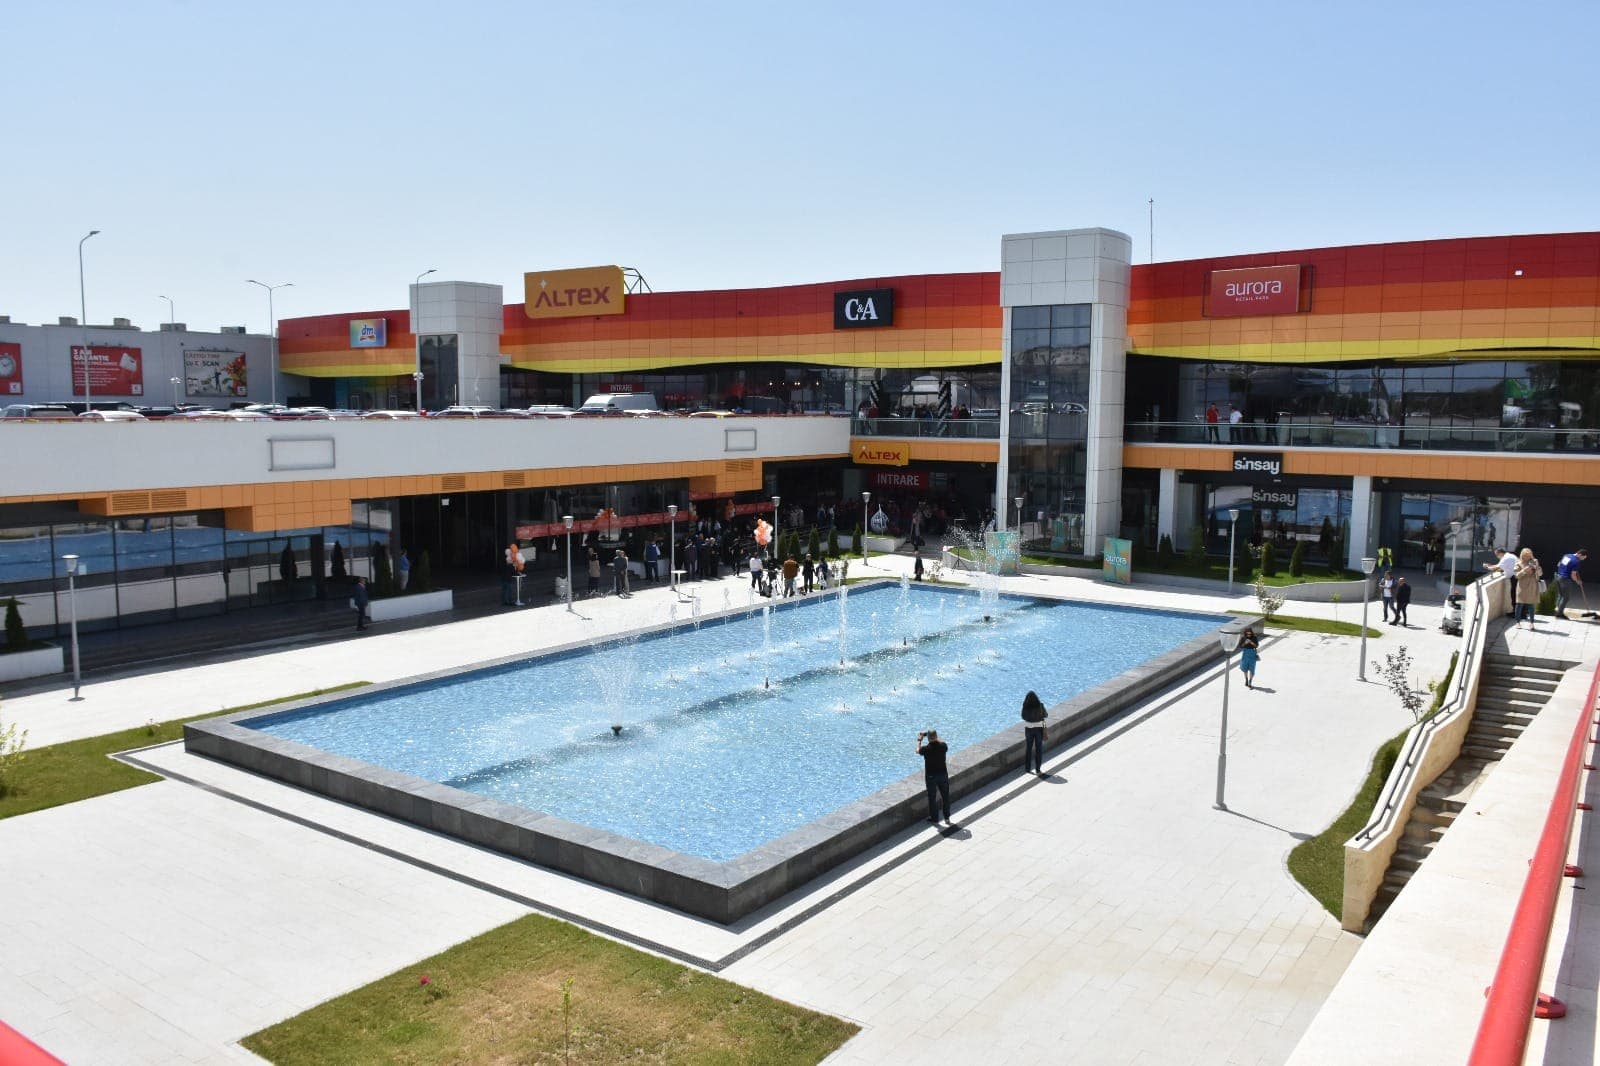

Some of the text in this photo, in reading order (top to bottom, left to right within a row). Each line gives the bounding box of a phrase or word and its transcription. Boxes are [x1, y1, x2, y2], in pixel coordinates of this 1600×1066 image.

[1225, 280, 1282, 297] aurora
[844, 297, 878, 321] C&A
[361, 324, 374, 336] dm
[1234, 457, 1280, 475] sinsay
[877, 473, 920, 486] INTRARE
[1253, 489, 1296, 507] sinsay
